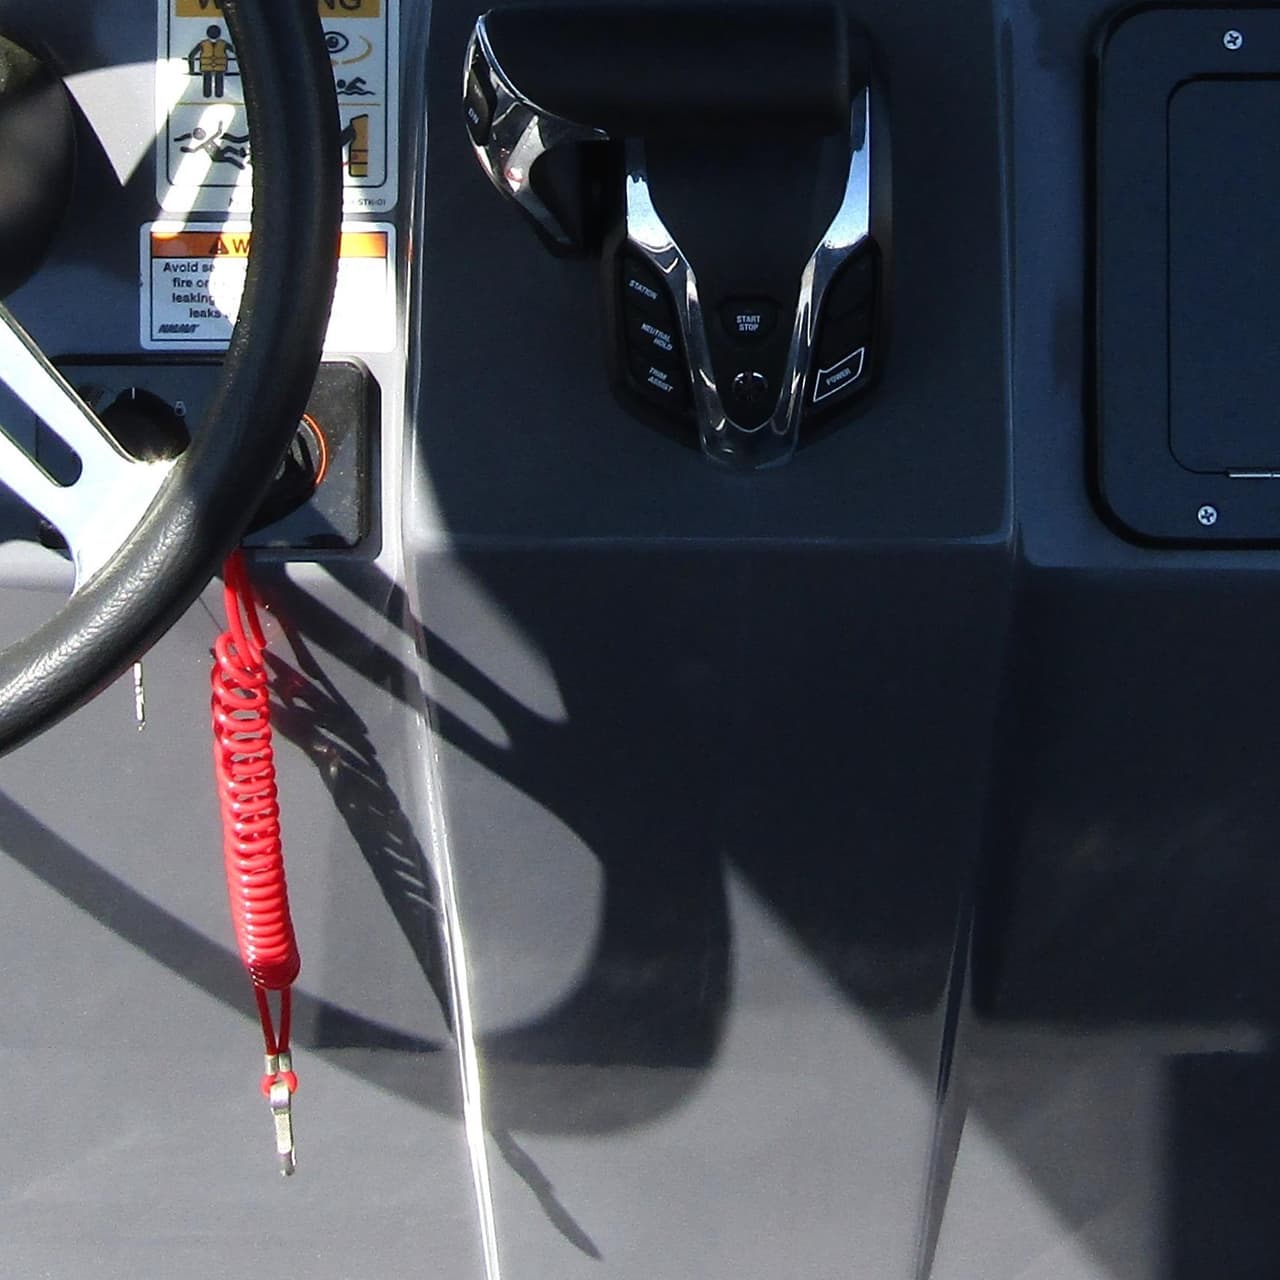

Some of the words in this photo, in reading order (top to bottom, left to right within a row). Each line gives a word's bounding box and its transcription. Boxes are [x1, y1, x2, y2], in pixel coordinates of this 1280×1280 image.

[163, 262, 199, 272] Avoid
[172, 277, 193, 288] fire
[628, 280, 658, 300] STATION
[736, 315, 760, 324] START
[641, 323, 671, 342] NEUTRAL
[653, 338, 673, 351] HOLD
[826, 367, 851, 385] POWER
